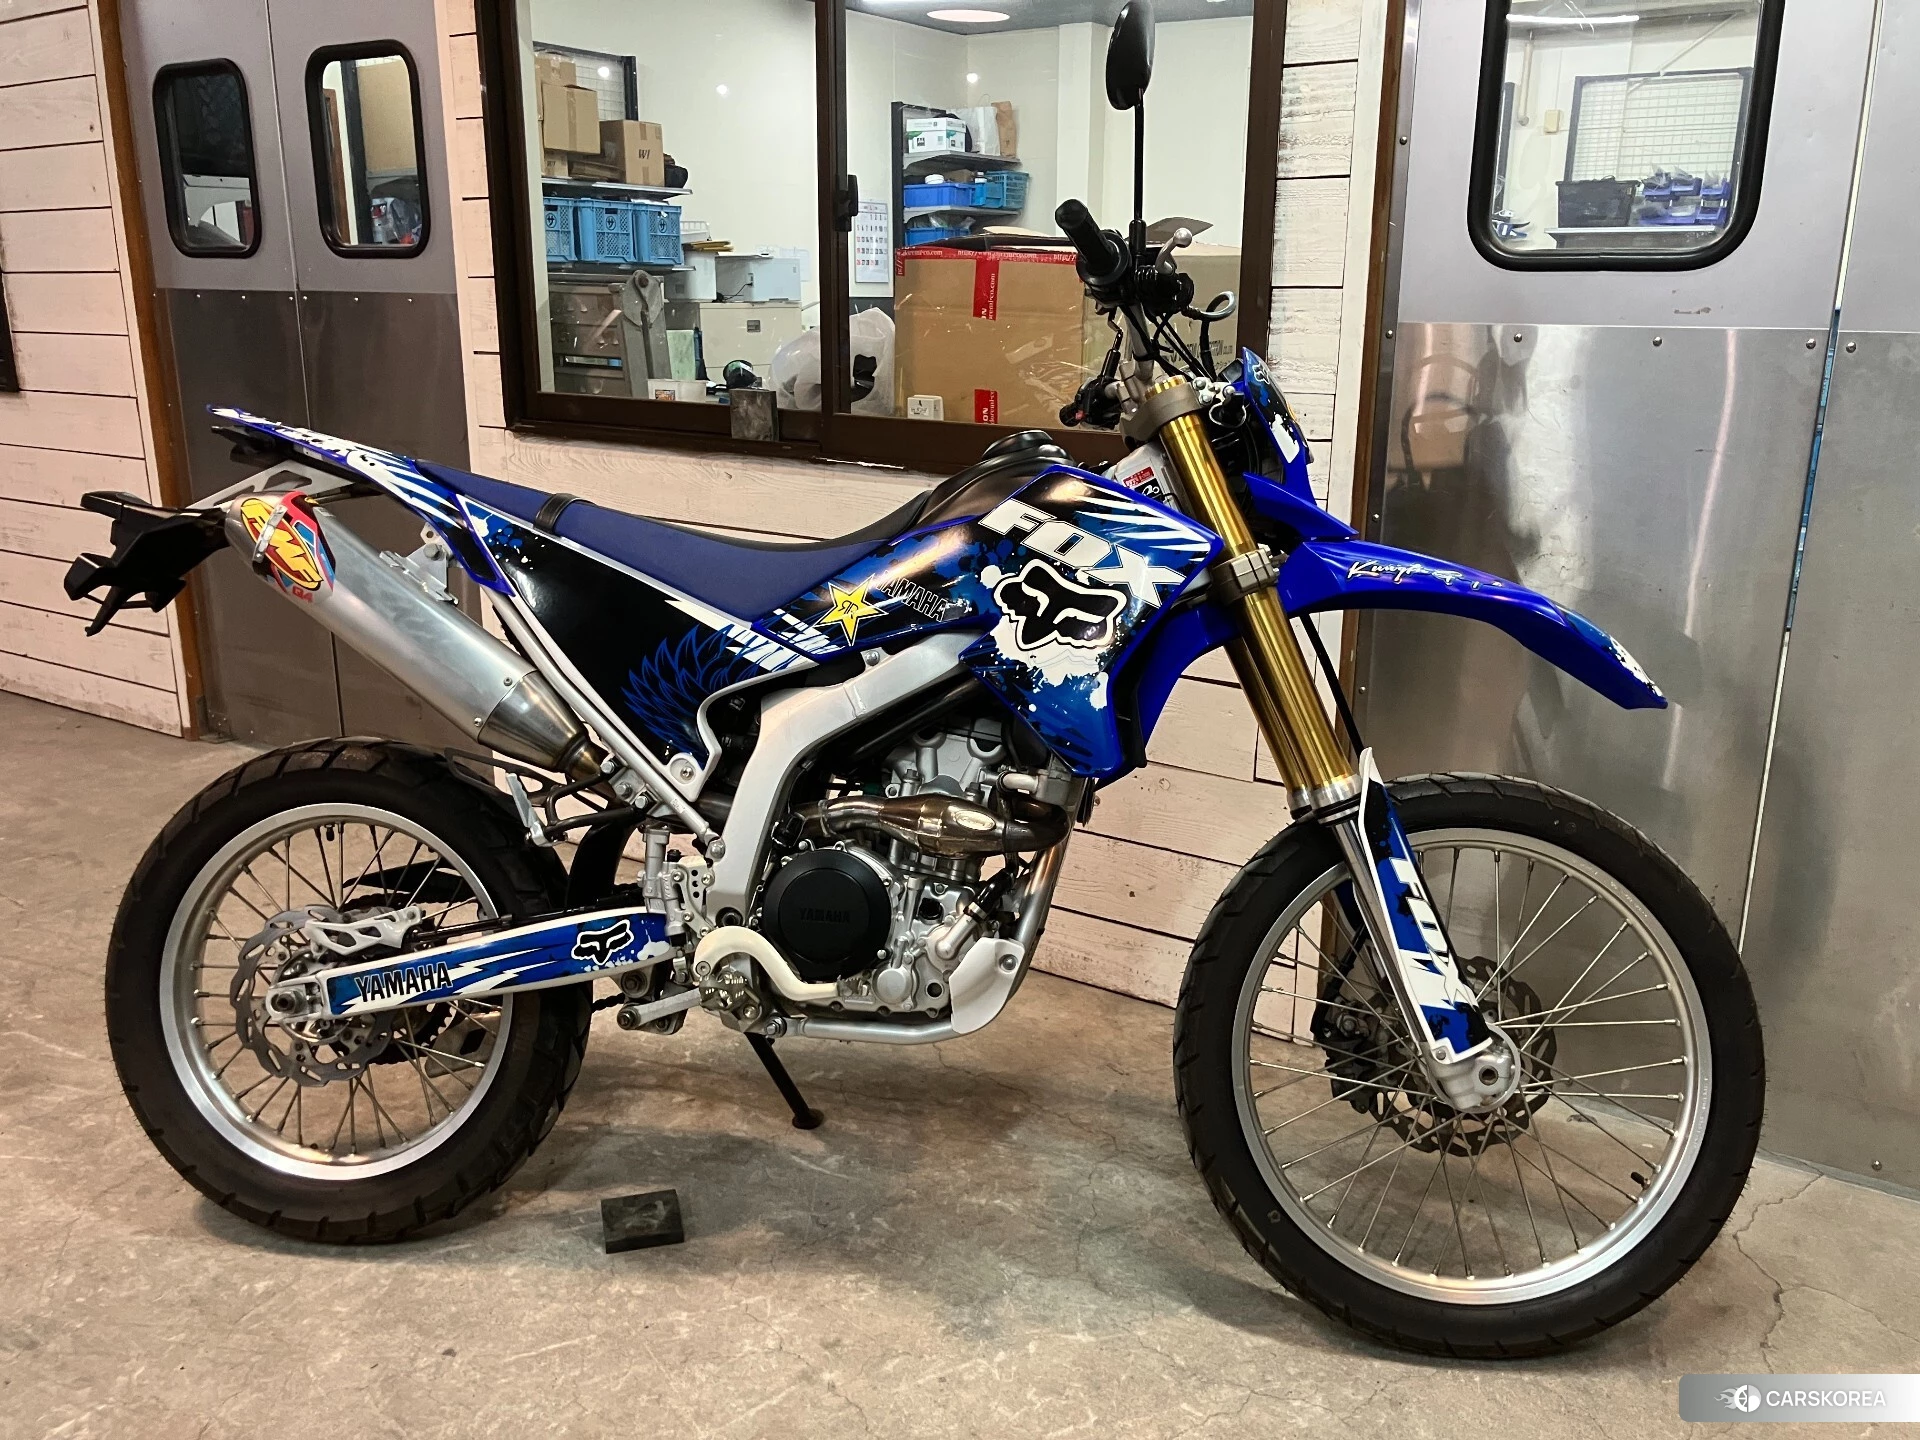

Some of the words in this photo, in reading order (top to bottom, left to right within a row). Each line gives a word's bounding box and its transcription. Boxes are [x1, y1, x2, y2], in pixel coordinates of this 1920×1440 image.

[978, 498, 1187, 609] FOX
[799, 907, 851, 923] YAMAHA
[1389, 857, 1479, 1012] FOX
[354, 961, 453, 1003] YAMAHA
